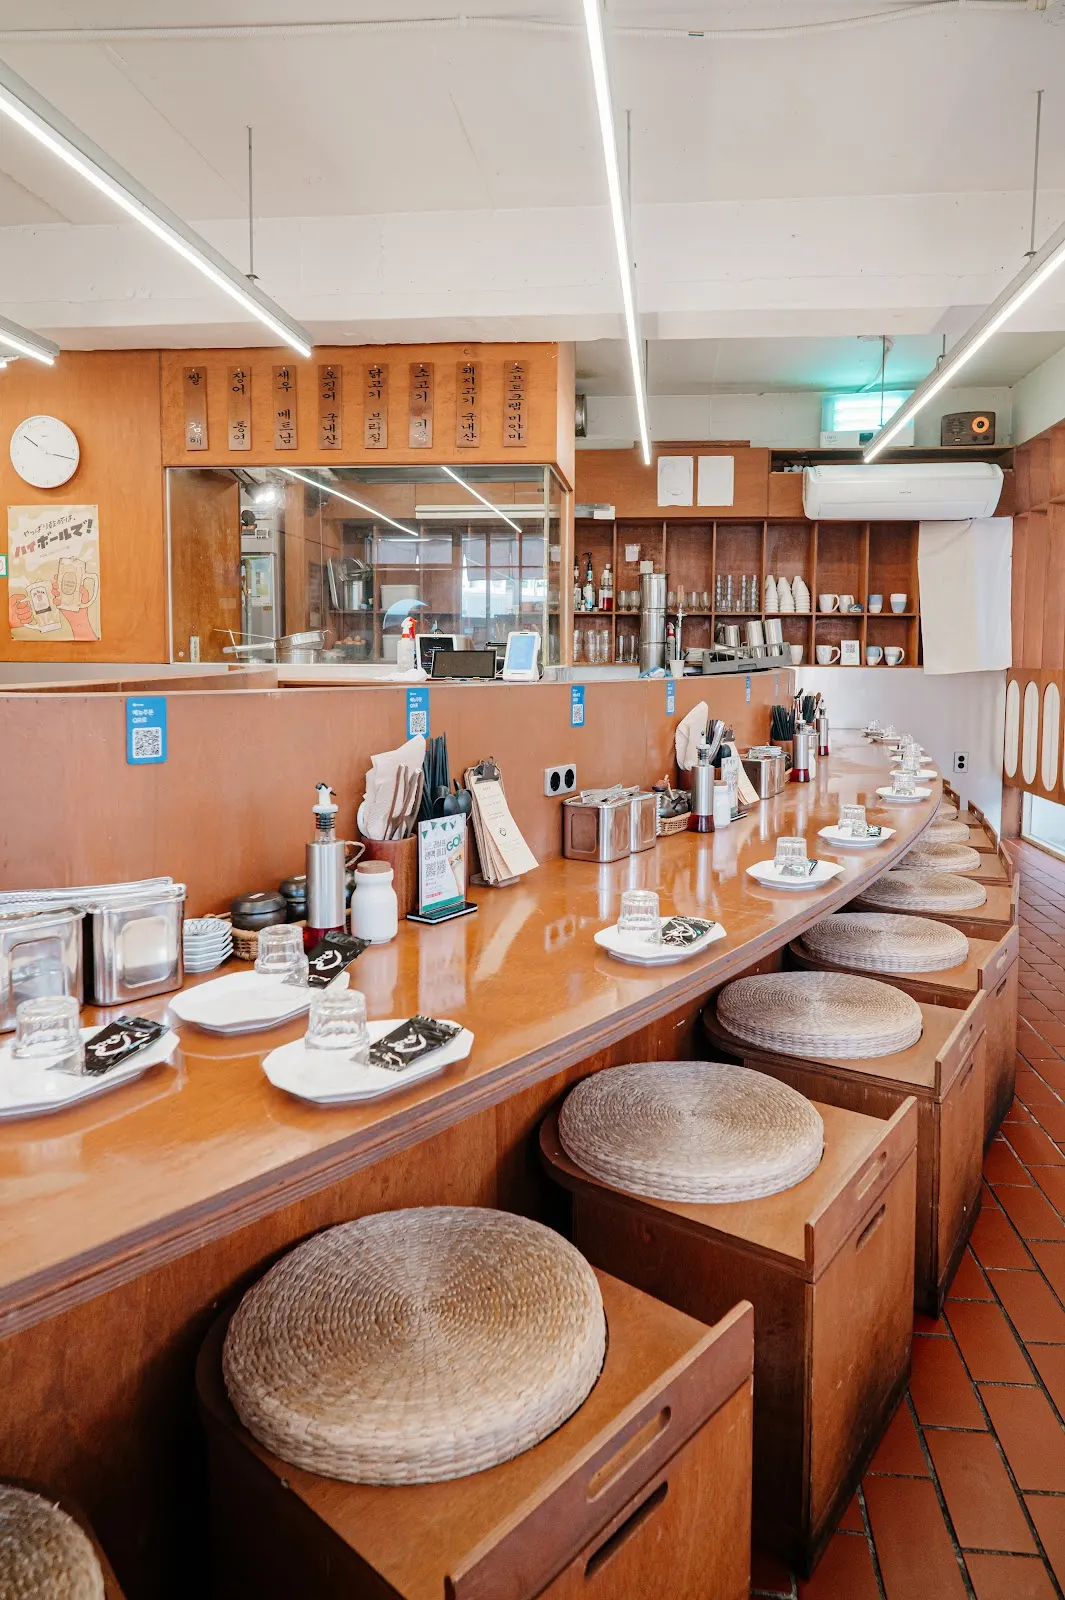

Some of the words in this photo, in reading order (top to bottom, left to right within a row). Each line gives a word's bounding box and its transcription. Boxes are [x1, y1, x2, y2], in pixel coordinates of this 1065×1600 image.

[188, 372, 202, 386] 쌀
[232, 371, 247, 395] 장어
[277, 370, 292, 392] 새우
[322, 370, 338, 402] 오징어
[368, 369, 384, 400] 닭고기
[414, 368, 430, 403] 소고기
[461, 366, 478, 406] 돼지고기
[508, 366, 525, 411] 소프트크랩
[232, 420, 247, 446] 통영
[277, 409, 294, 444] 베트남
[322, 412, 338, 445] 국내산
[368, 412, 382, 443] 브라질
[461, 412, 477, 442] 국내산
[508, 413, 525, 441] 미얀마
[446, 834, 463, 852] GO!
